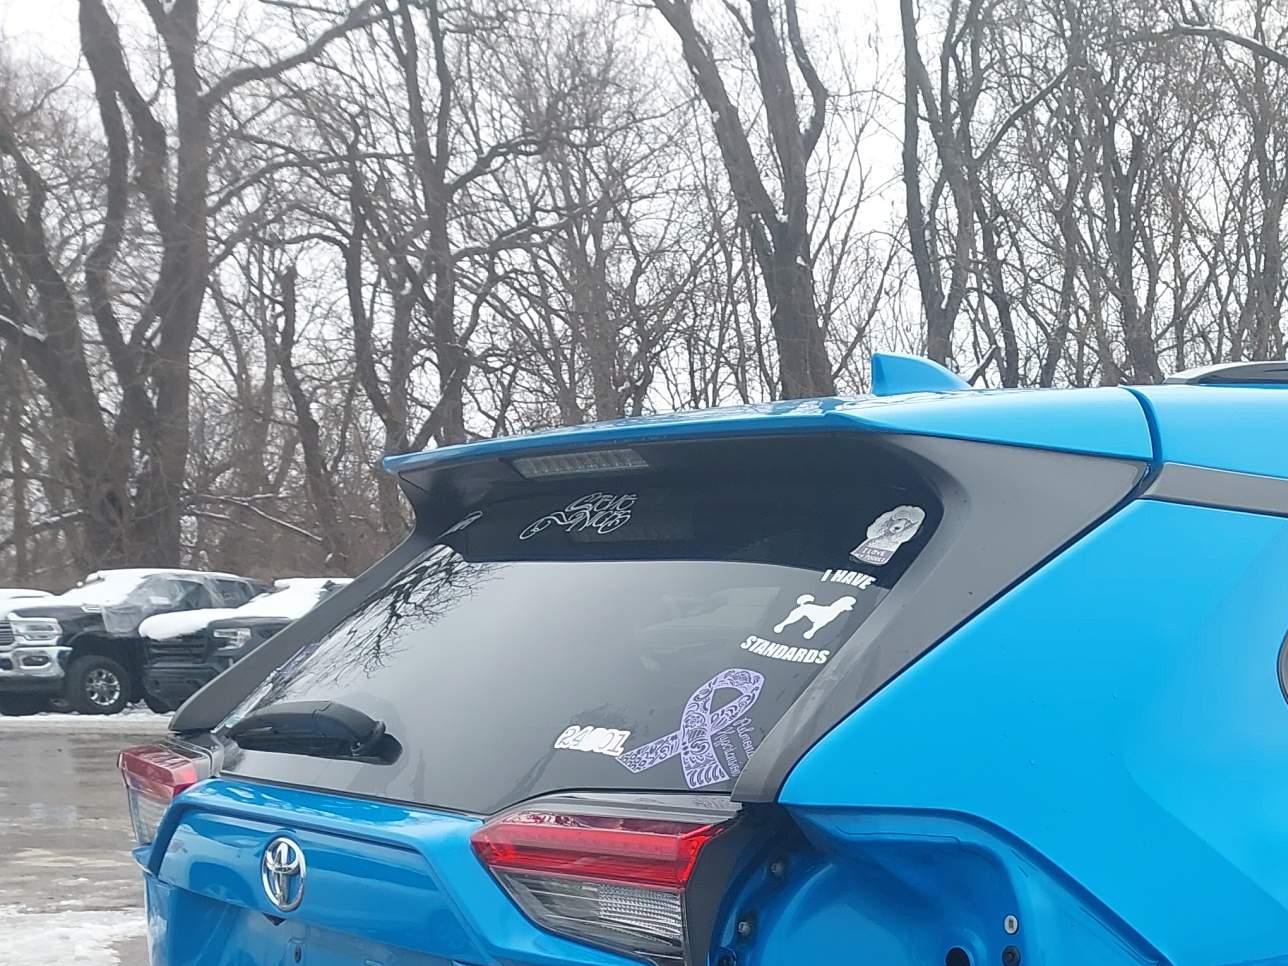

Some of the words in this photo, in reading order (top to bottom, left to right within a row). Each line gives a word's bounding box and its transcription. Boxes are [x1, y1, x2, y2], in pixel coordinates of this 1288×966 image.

[820, 569, 832, 582] I
[830, 569, 877, 590] HAVE
[740, 635, 830, 664] STANDARDS
